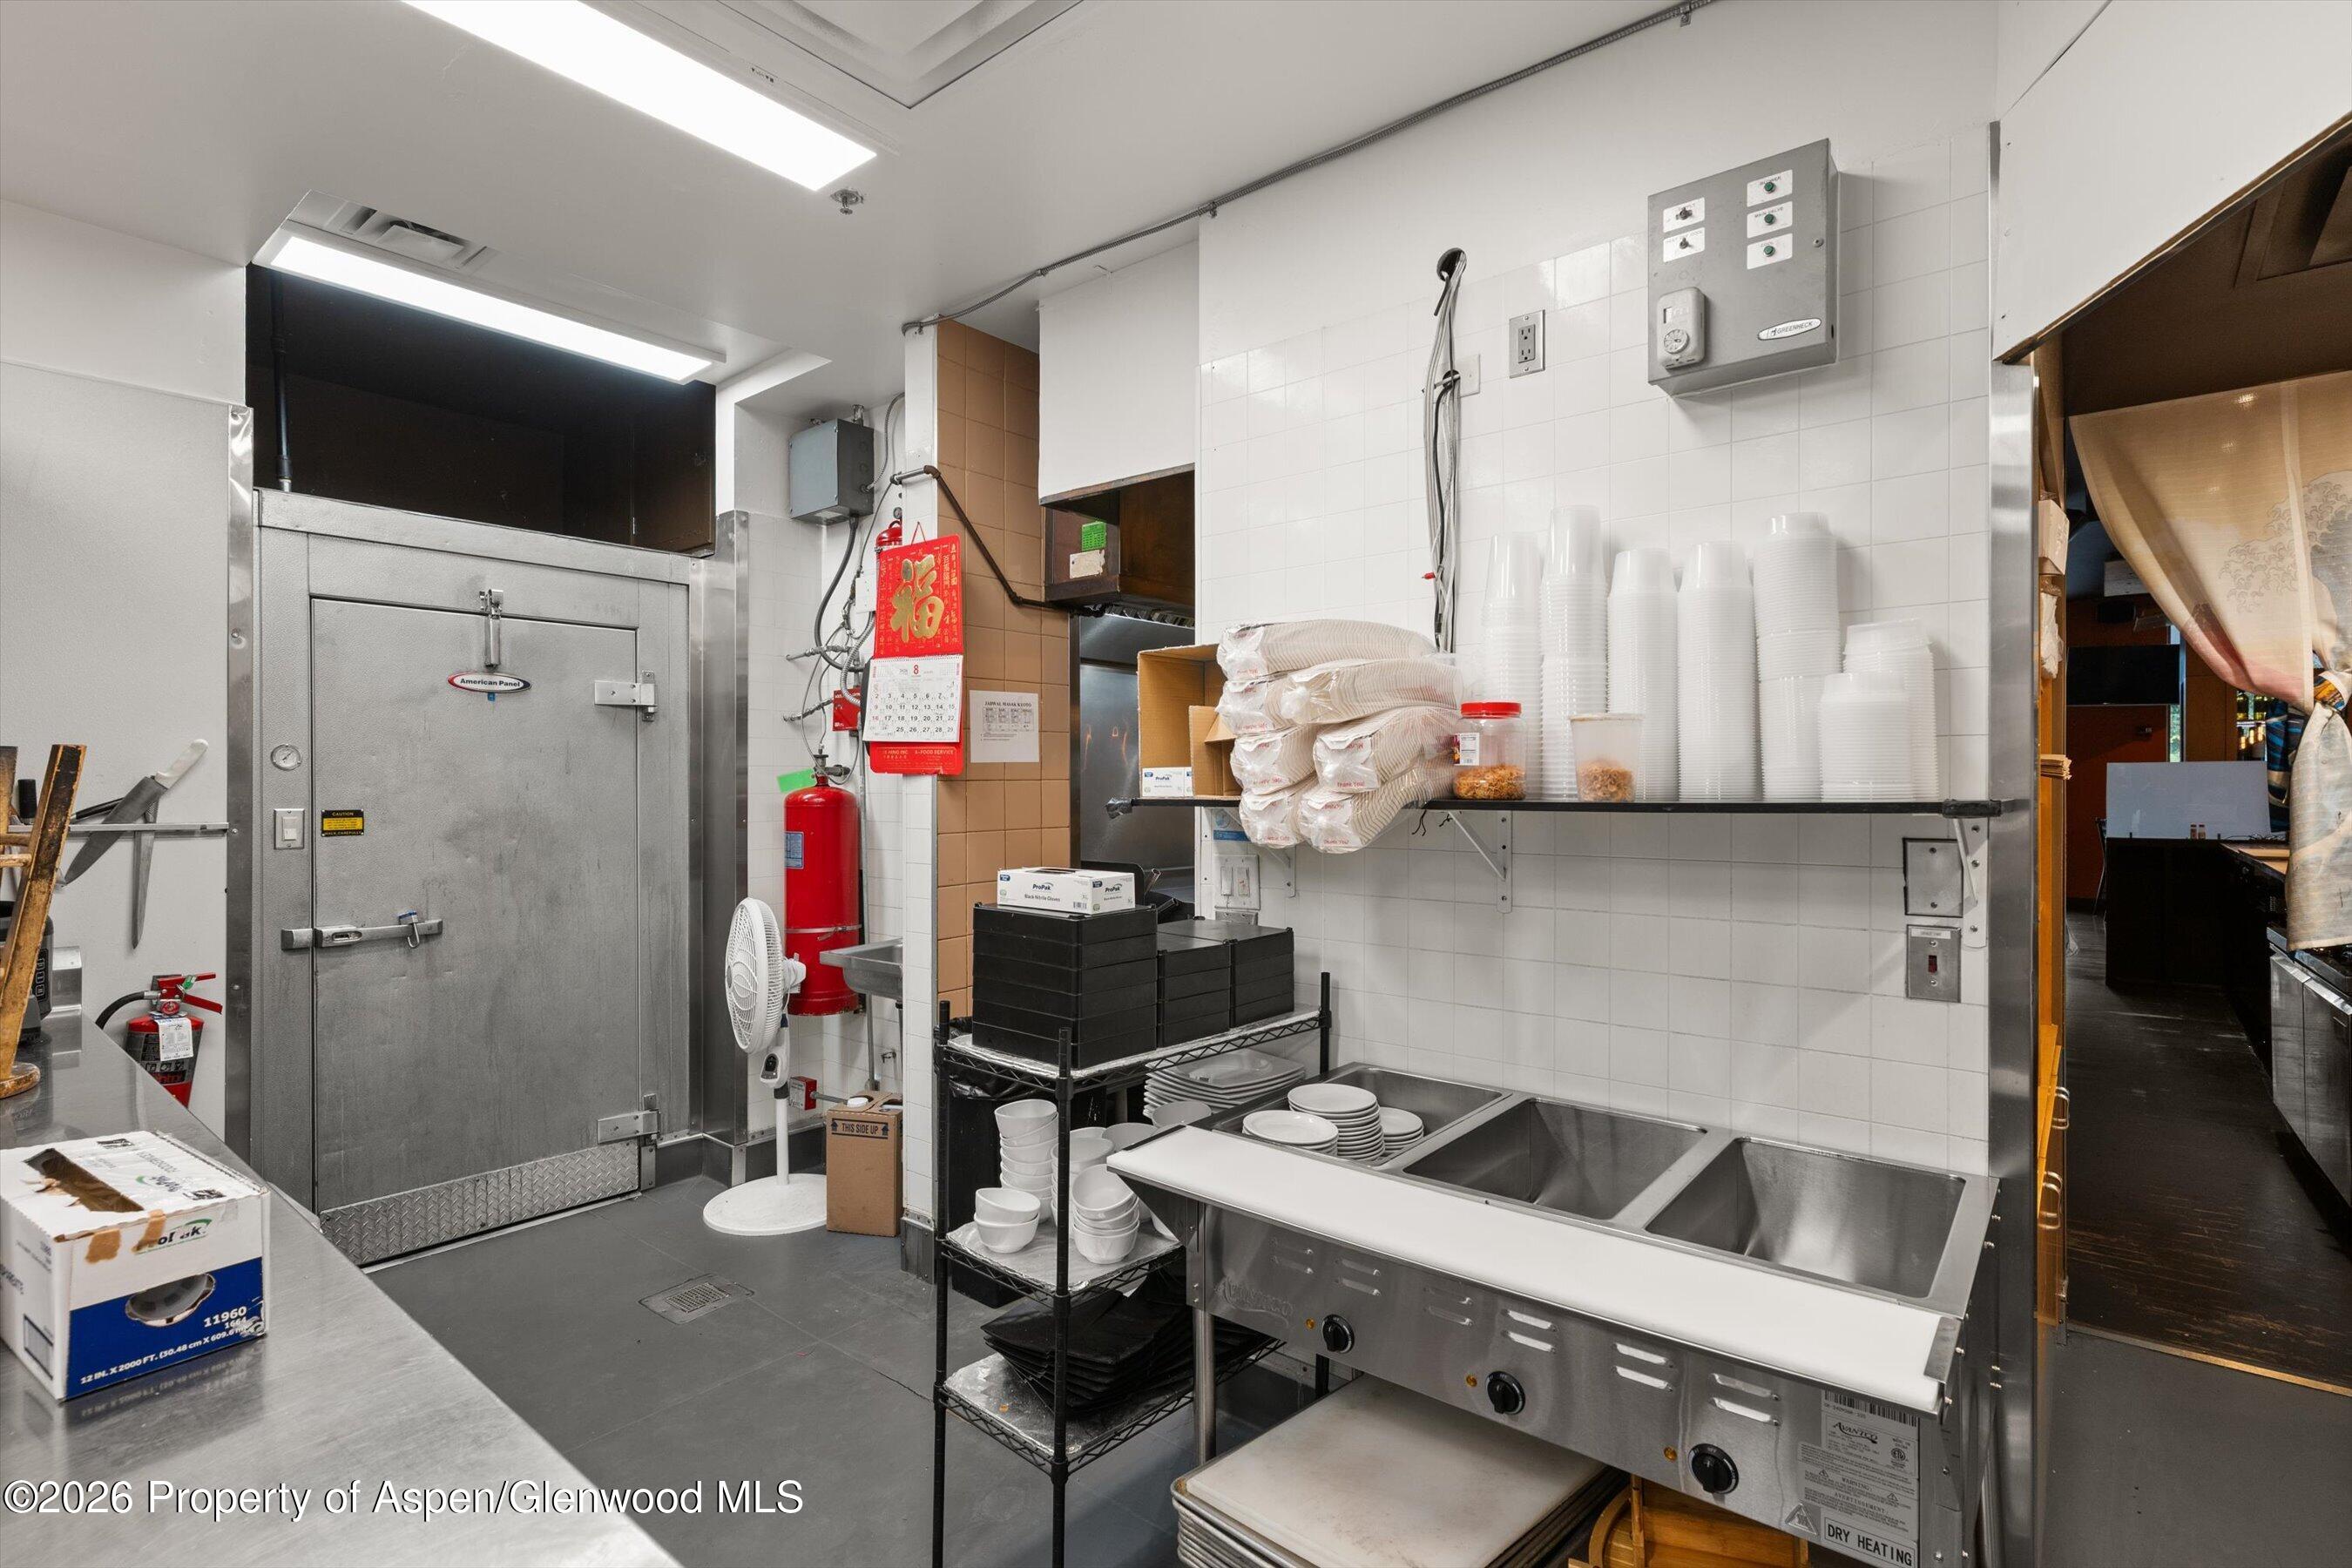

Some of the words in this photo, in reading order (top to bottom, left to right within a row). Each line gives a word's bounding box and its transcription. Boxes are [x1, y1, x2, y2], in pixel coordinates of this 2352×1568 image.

[1777, 321, 1813, 335] GREENHECK
[913, 664, 919, 675] 8
[841, 1122, 855, 1132] THIS
[855, 1124, 869, 1134] SIDE
[869, 1125, 879, 1135] UP
[203, 1305, 247, 1328] 11960
[80, 1374, 94, 1385] 12
[94, 1368, 109, 1382] IN.
[109, 1365, 118, 1375] X
[118, 1358, 142, 1372] 2000
[142, 1353, 159, 1365] FT.
[159, 1342, 188, 1360] (30.48
[188, 1339, 202, 1349] cm
[210, 1328, 235, 1342] 609.6
[1833, 1421, 1878, 1444] AVANTCO
[1828, 1524, 1850, 1543] DRY
[1857, 1534, 1912, 1567] HEATING
